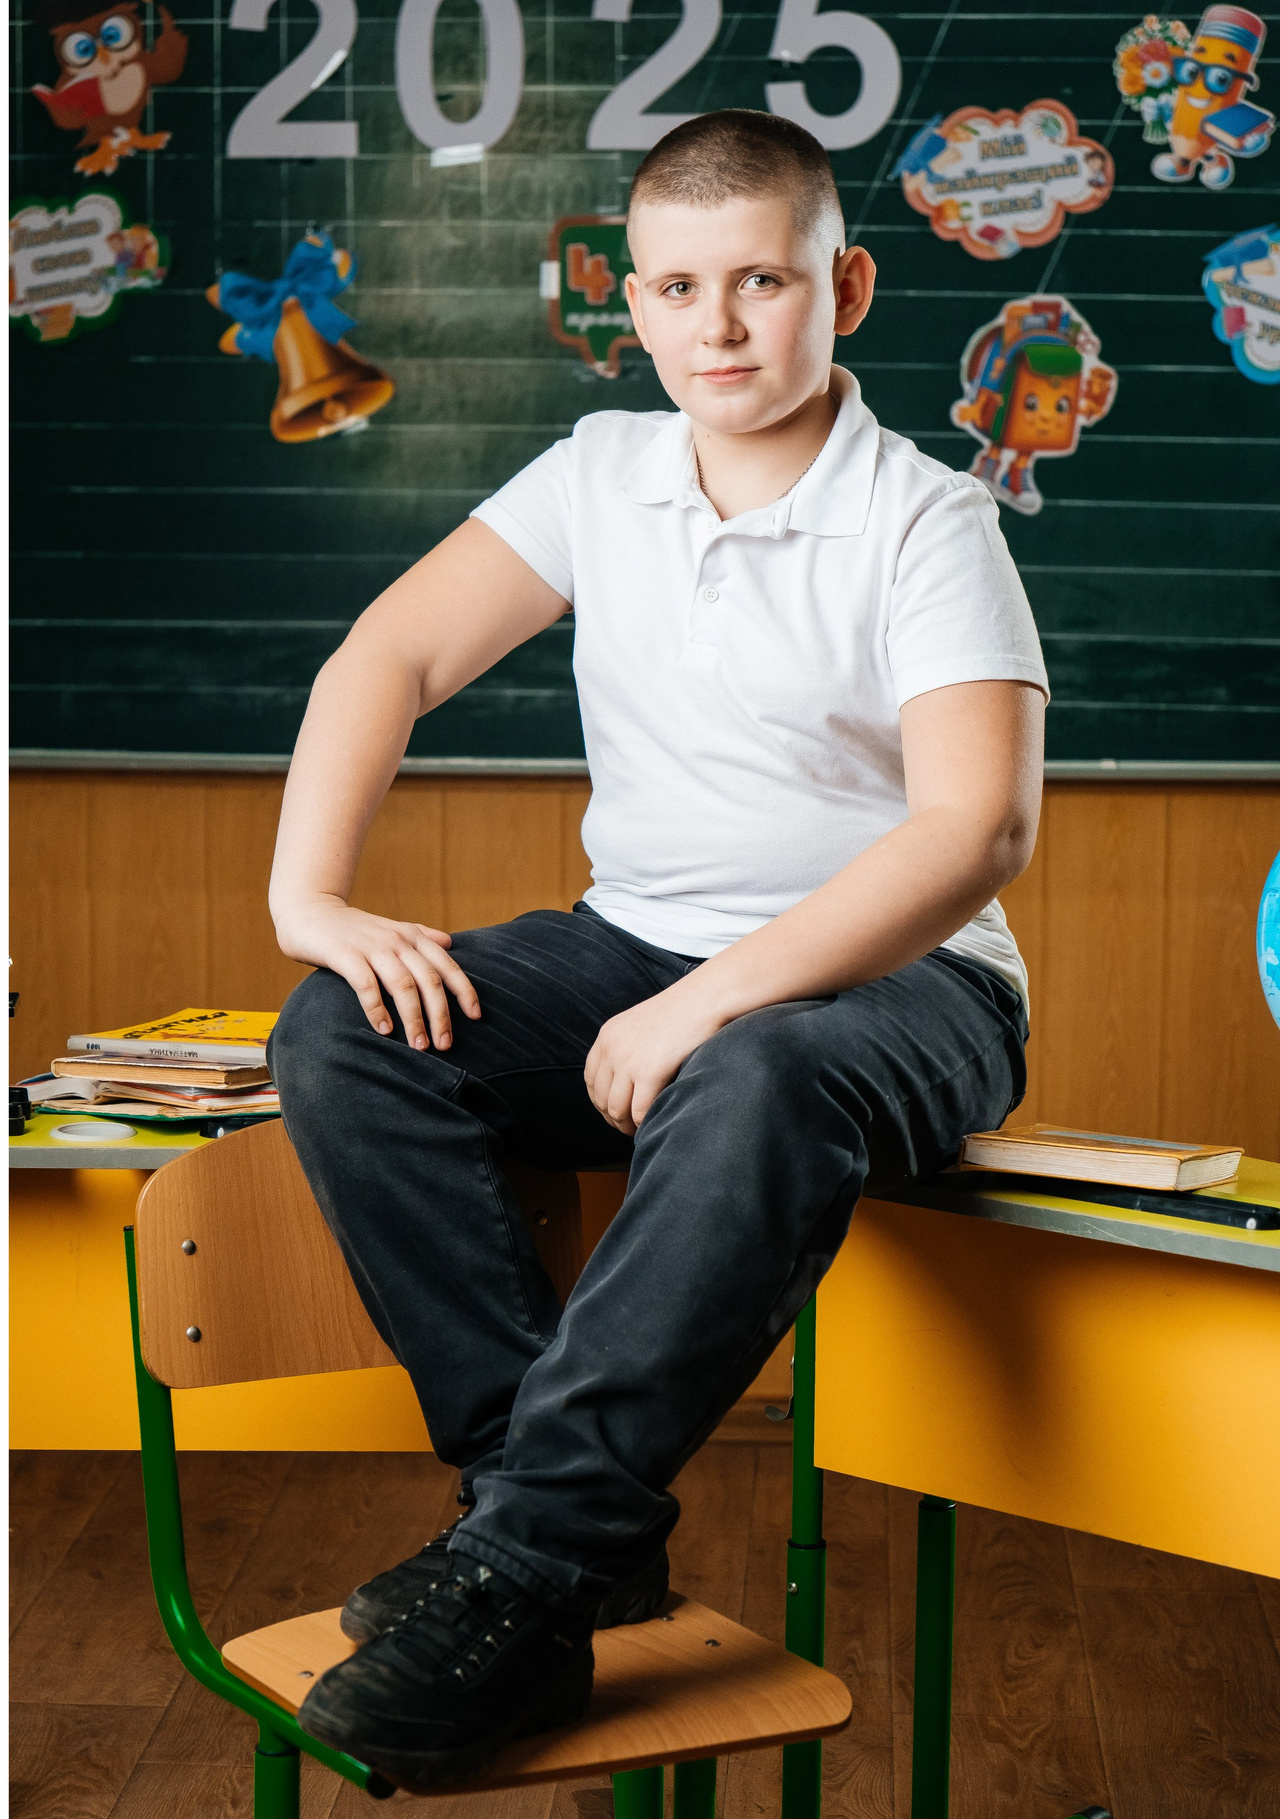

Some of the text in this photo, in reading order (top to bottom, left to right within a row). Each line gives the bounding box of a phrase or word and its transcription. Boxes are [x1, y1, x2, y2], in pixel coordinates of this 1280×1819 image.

[227, 0, 903, 159] 2025
[979, 133, 1027, 161] Мій
[566, 242, 617, 306] 4
[149, 1047, 199, 1059] МАТЕМАТИКА
